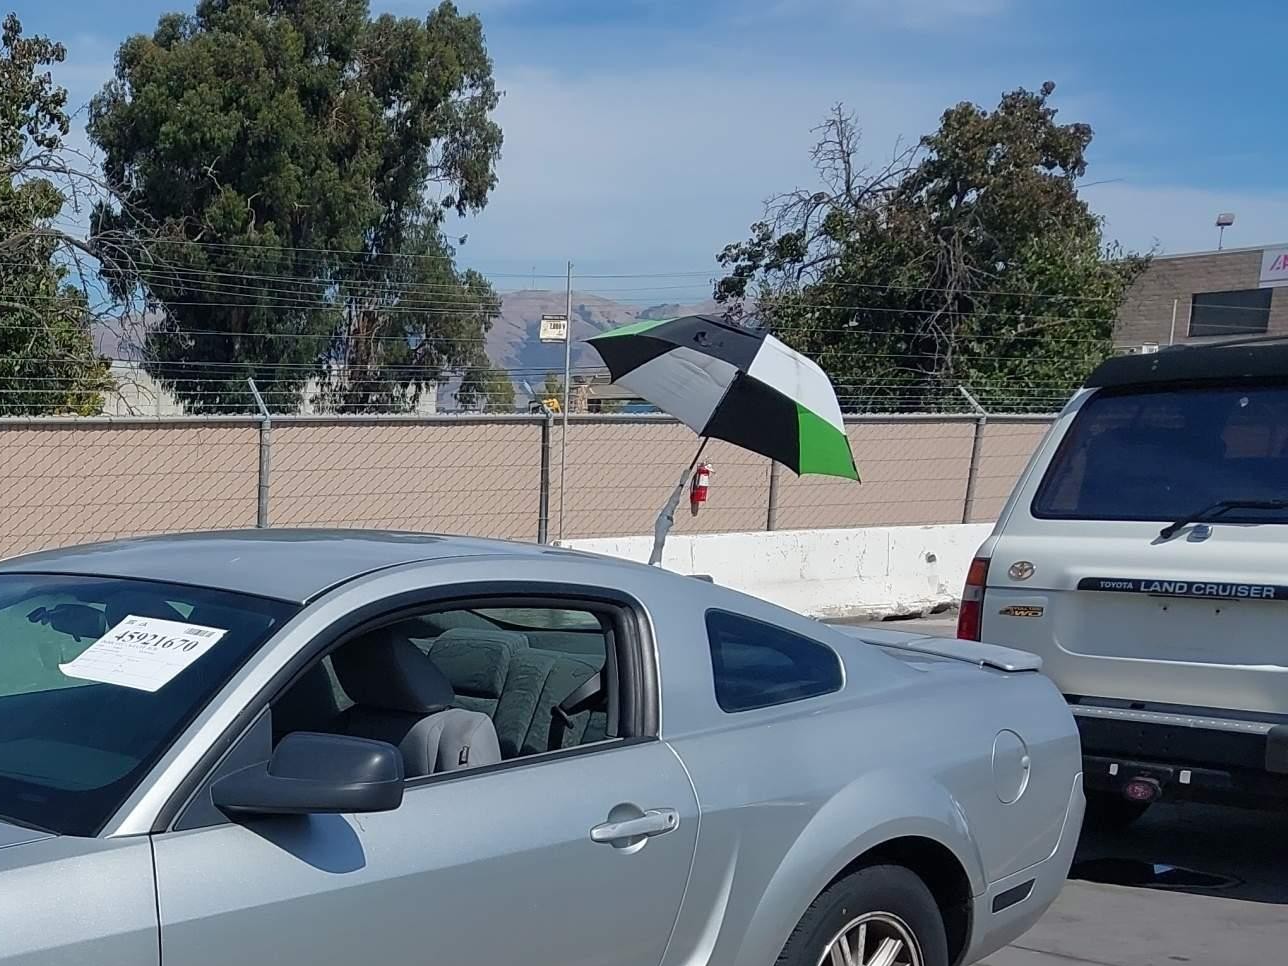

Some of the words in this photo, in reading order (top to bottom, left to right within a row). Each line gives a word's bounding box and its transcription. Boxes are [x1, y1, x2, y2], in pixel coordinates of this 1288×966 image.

[1099, 580, 1133, 589] TOYOTA
[1140, 581, 1188, 594] LAND
[1191, 583, 1275, 598] CRUISER
[114, 630, 199, 652] 45921670
